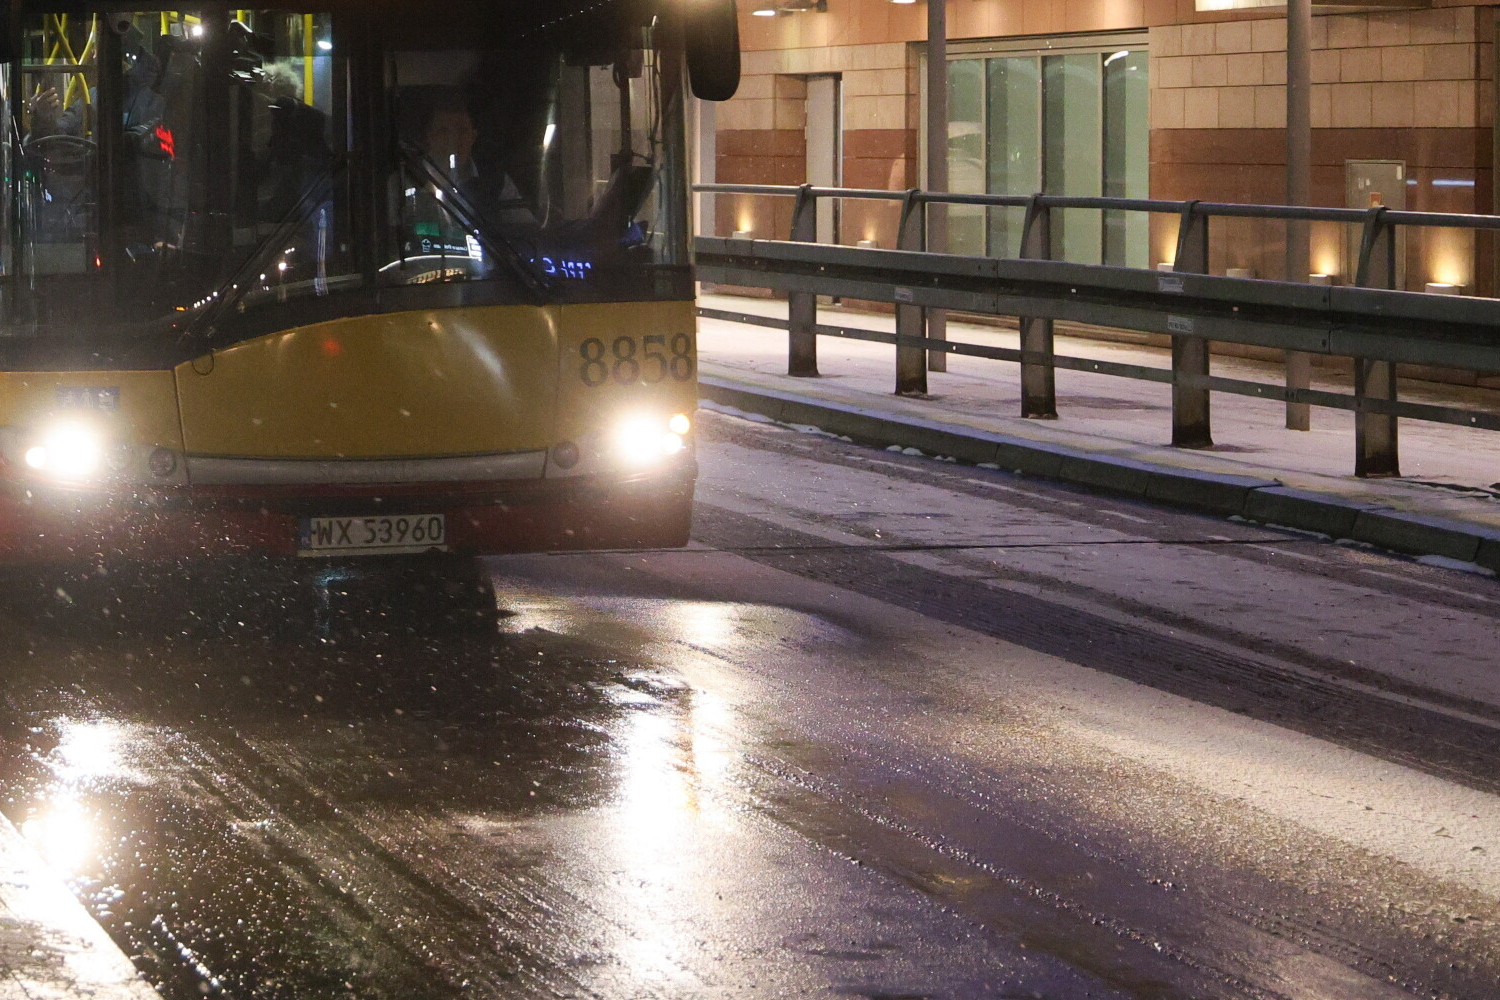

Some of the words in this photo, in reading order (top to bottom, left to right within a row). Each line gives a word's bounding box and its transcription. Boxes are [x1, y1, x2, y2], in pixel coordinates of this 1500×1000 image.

[579, 332, 693, 388] 8858
[315, 519, 353, 546] WX
[362, 516, 442, 544] 53960
